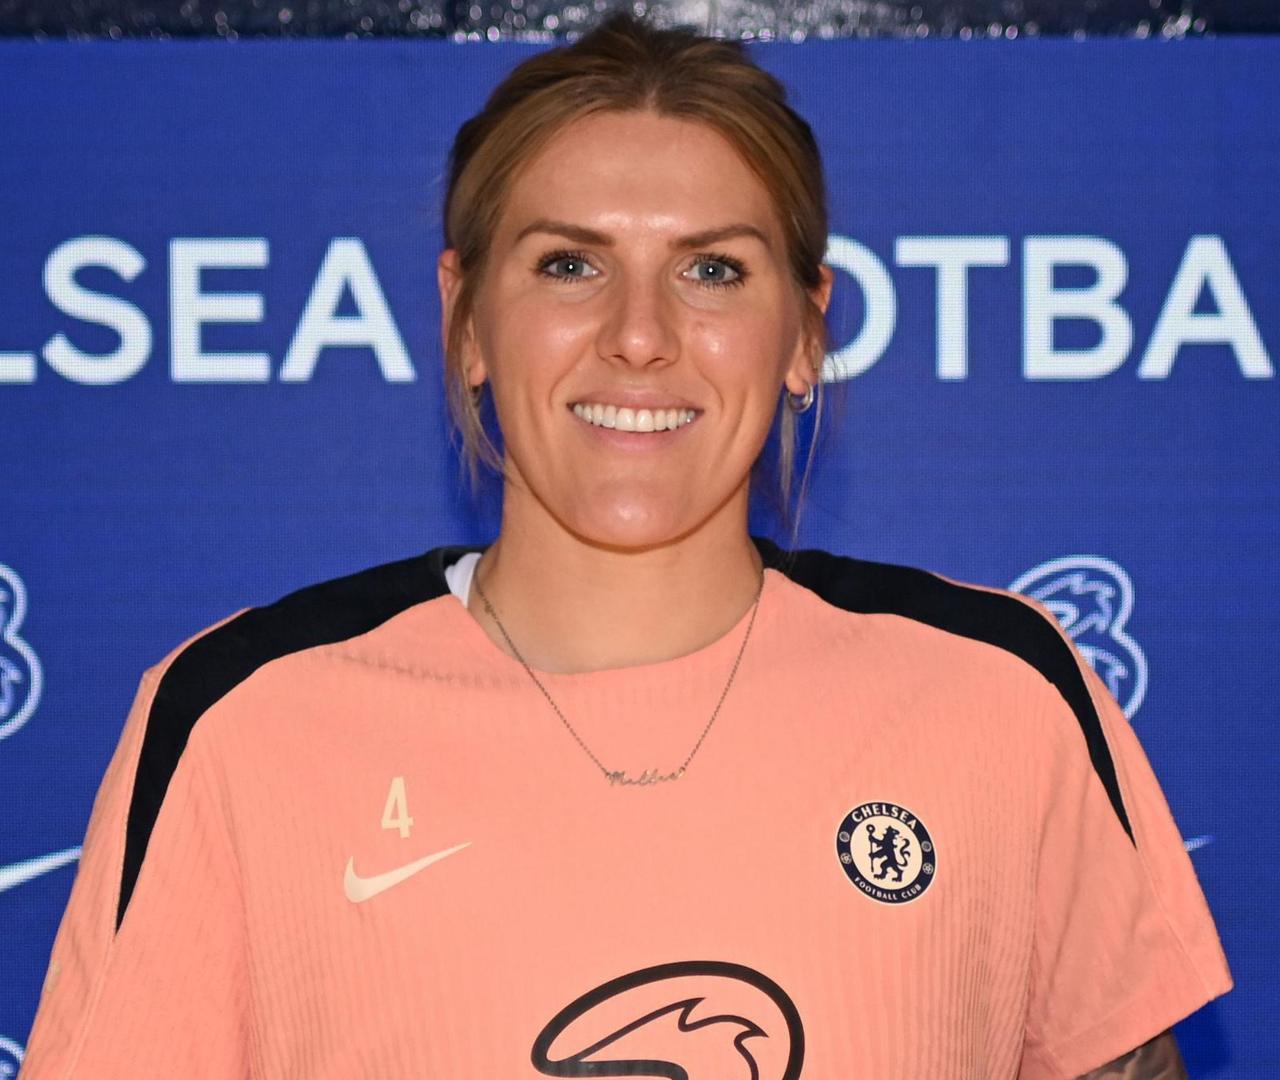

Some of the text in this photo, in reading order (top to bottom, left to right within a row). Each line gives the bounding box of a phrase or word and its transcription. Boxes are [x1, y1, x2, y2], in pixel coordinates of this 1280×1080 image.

[380, 777, 414, 838] 4
[852, 804, 916, 830] CHELSEA
[854, 877, 922, 900] FOOTBALL CLUB
